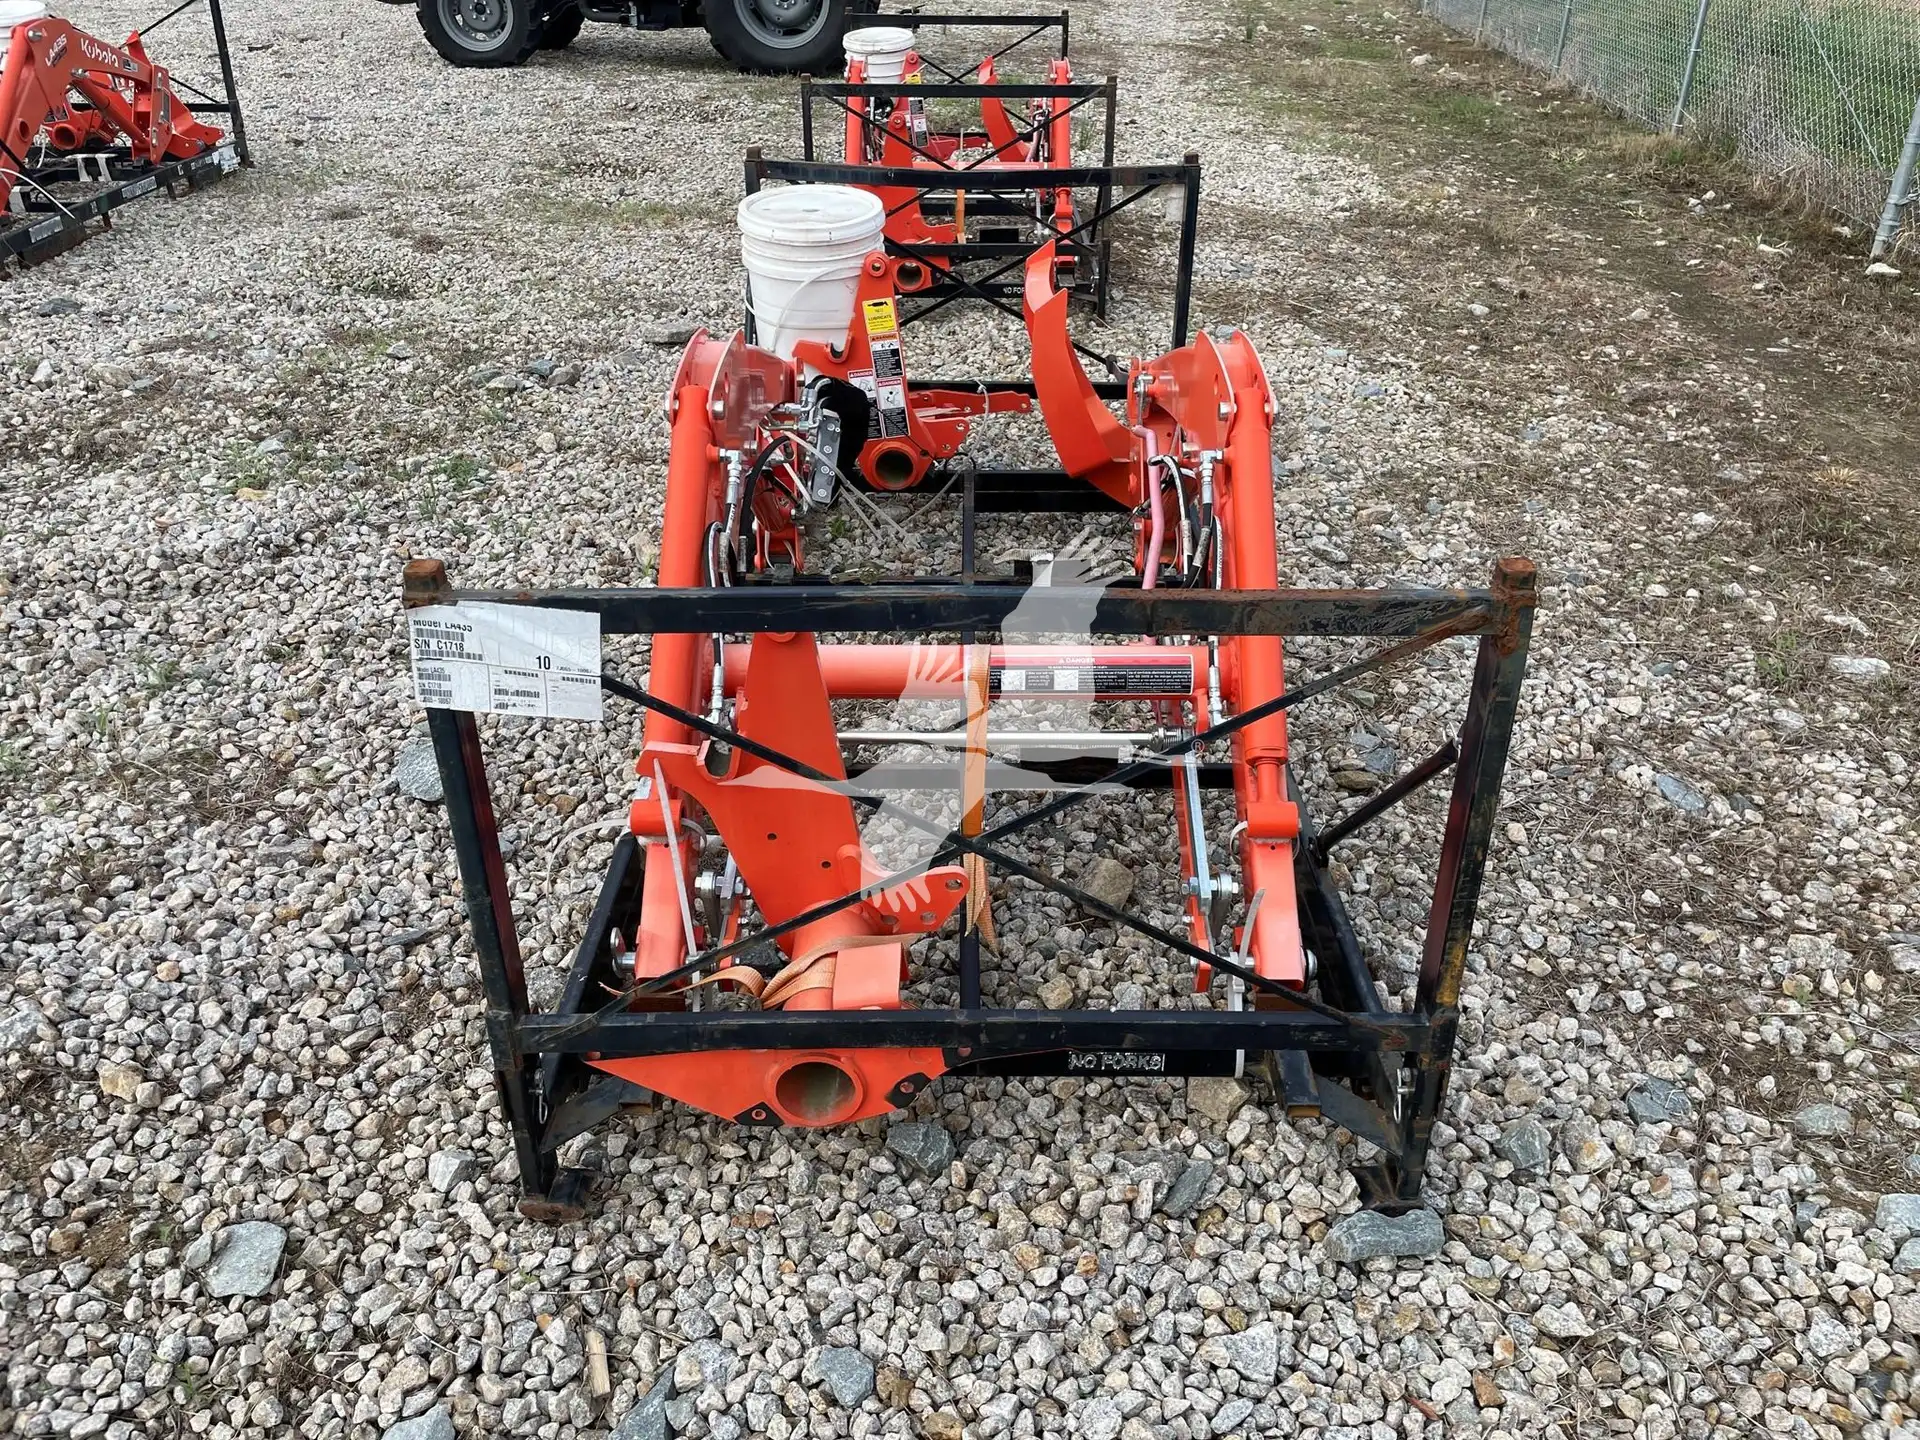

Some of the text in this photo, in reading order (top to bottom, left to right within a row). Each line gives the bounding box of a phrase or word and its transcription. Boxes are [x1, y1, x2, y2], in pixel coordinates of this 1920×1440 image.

[80, 37, 119, 68] Kubota
[414, 638, 465, 652] S/N C1718
[536, 655, 551, 670] 10
[1065, 657, 1096, 665] DANGER
[1069, 1053, 1162, 1071] NO FORKS
